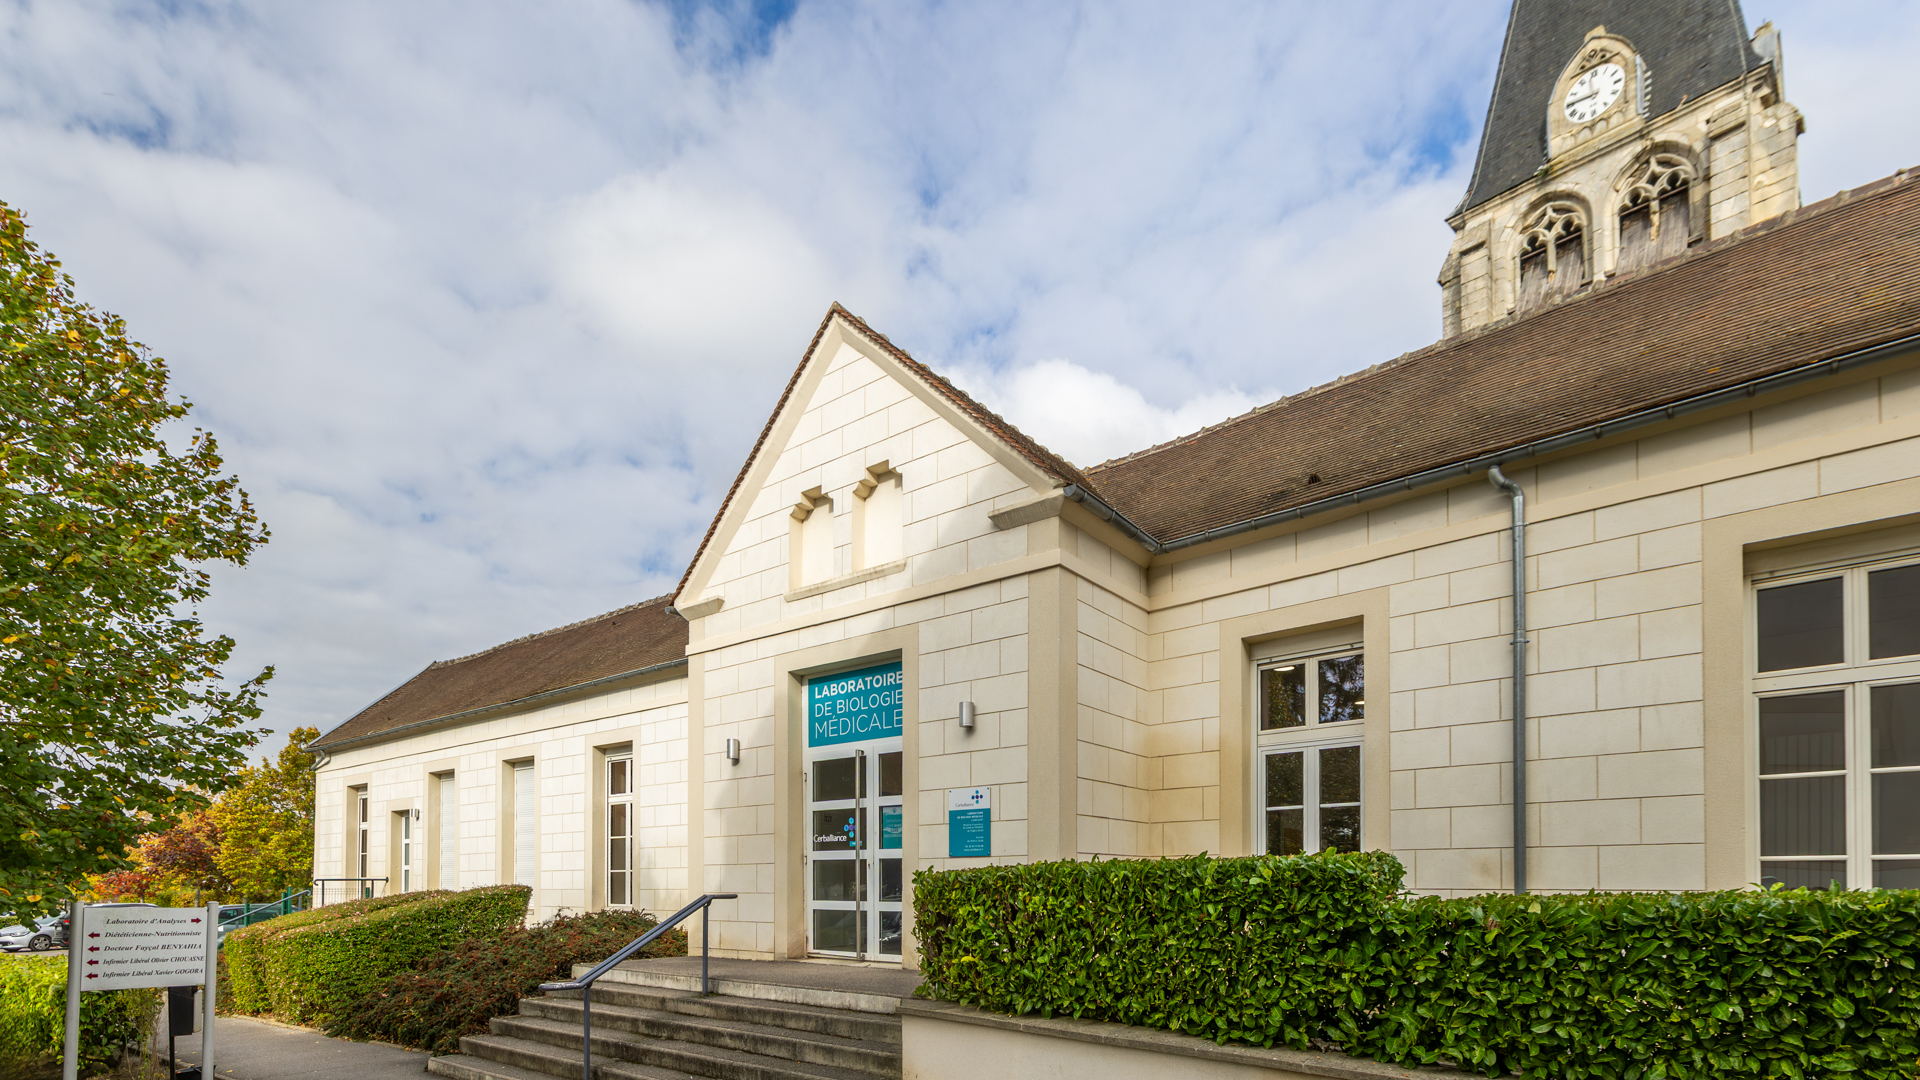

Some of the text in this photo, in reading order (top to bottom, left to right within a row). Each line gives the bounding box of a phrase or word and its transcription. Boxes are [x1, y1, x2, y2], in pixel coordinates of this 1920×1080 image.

[815, 671, 903, 699] LABORATOIRE
[815, 689, 903, 718] DE BIOLOGIE
[815, 708, 903, 739] MÉDICALE
[813, 834, 847, 843] Cerballiance
[135, 944, 160, 952] Fayçal
[102, 971, 131, 979] Infirmier
